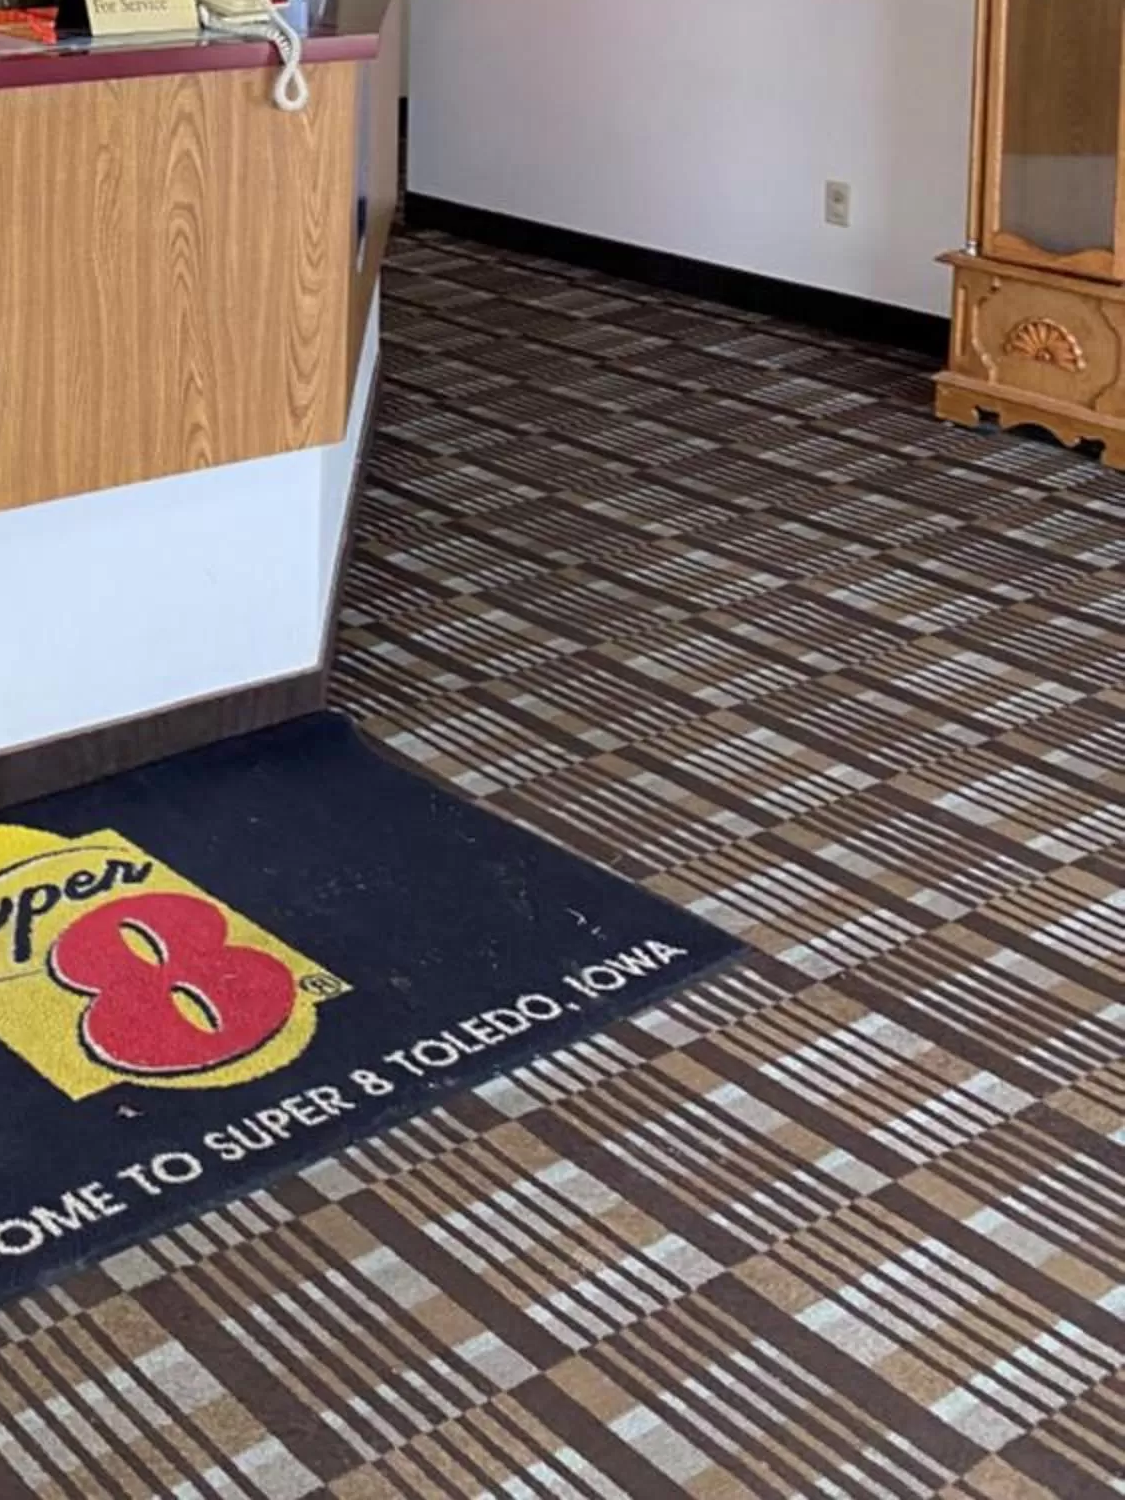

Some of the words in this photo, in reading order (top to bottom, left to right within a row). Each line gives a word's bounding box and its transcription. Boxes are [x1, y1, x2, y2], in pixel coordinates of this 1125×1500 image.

[46, 891, 297, 1078] 8
[117, 1151, 203, 1195] TO
[203, 1085, 356, 1160] SUPER
[349, 1069, 395, 1096] 8
[383, 993, 582, 1077] TOLEDO,
[562, 939, 689, 998] IOWA
